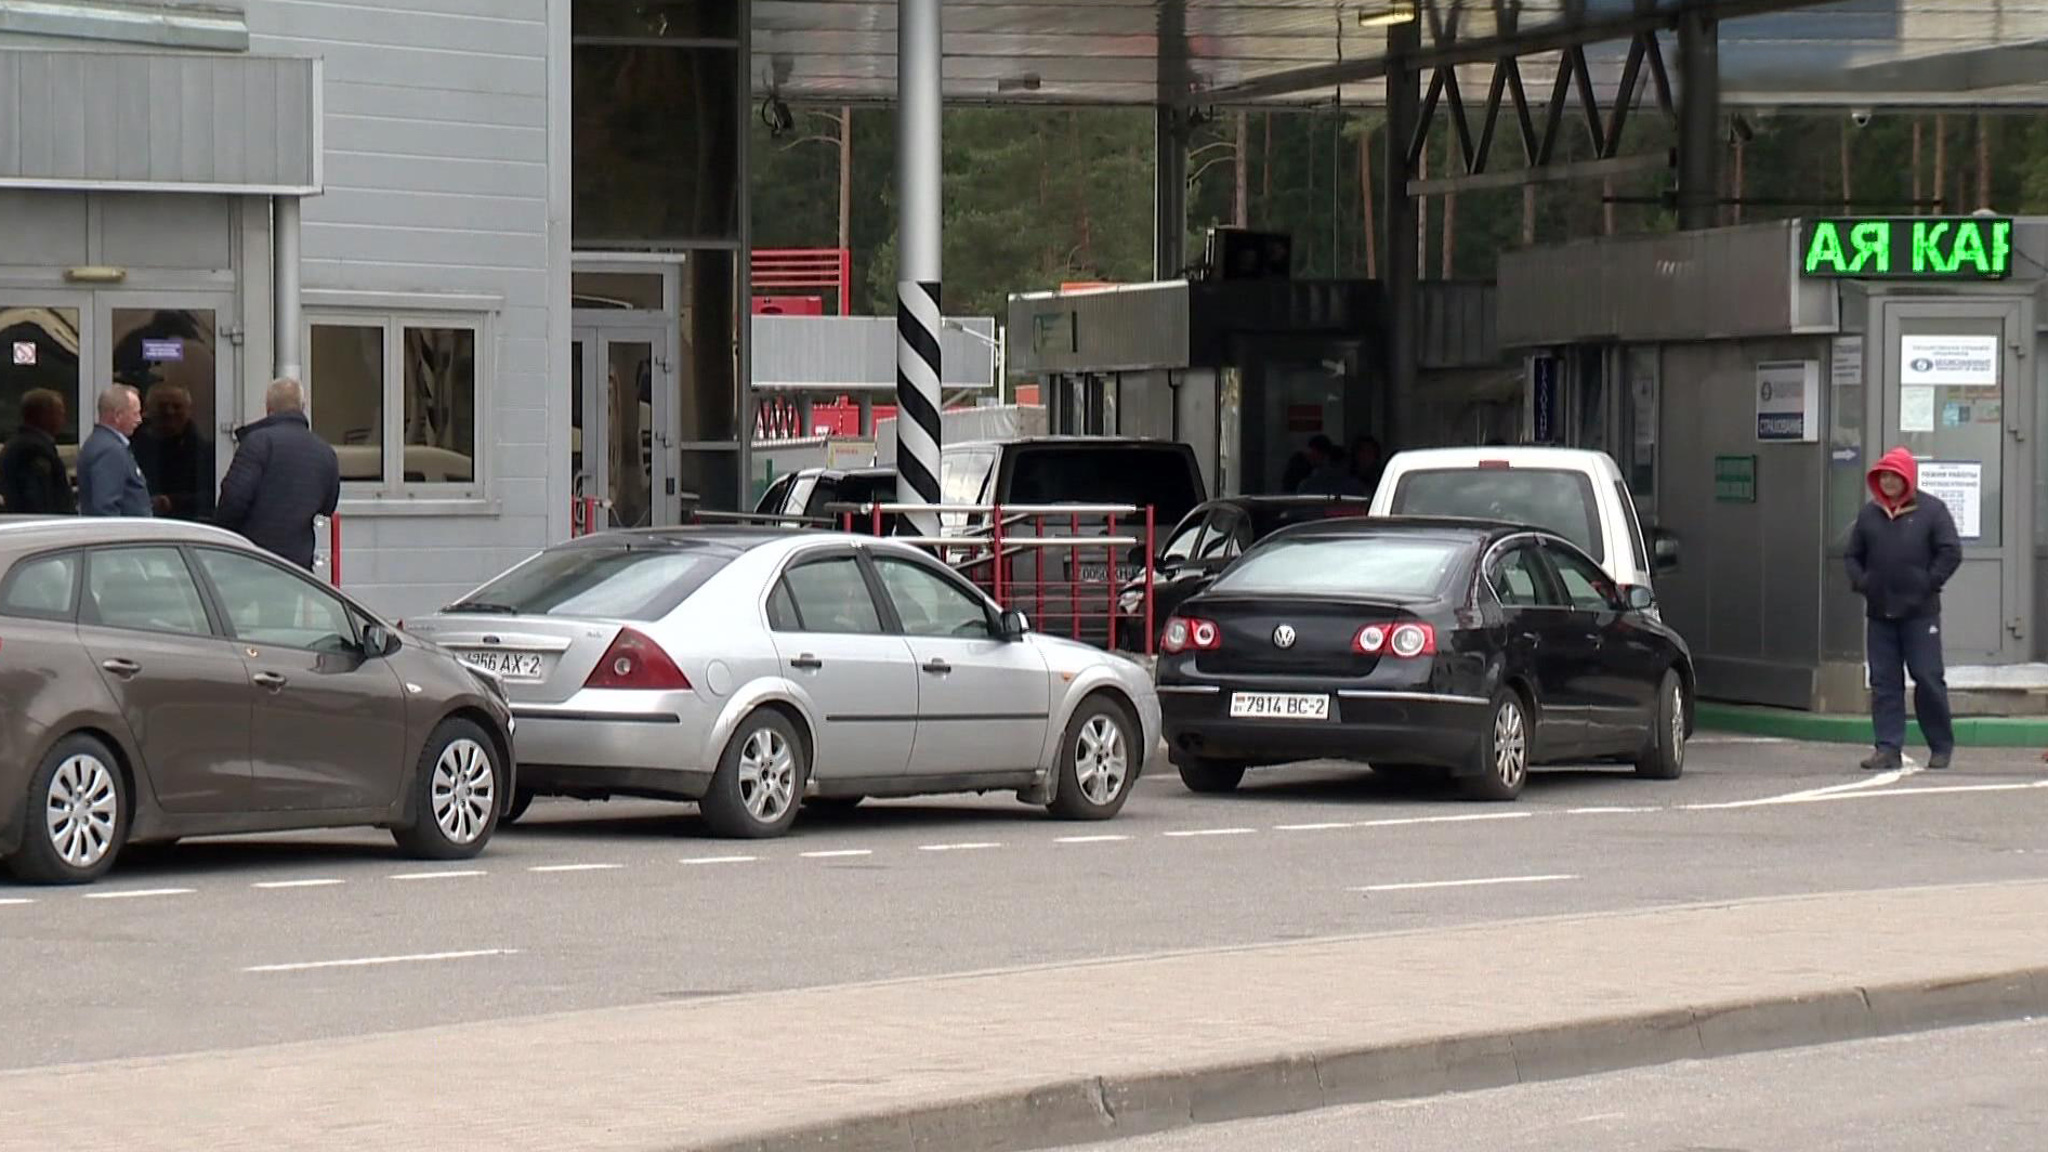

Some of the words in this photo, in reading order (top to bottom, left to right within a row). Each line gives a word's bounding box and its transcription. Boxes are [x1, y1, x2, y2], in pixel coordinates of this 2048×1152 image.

[1806, 221, 1889, 272] АЯ
[500, 653, 540, 675] AX-2
[1246, 696, 1281, 713] 7914
[1287, 697, 1325, 715] BC-2
